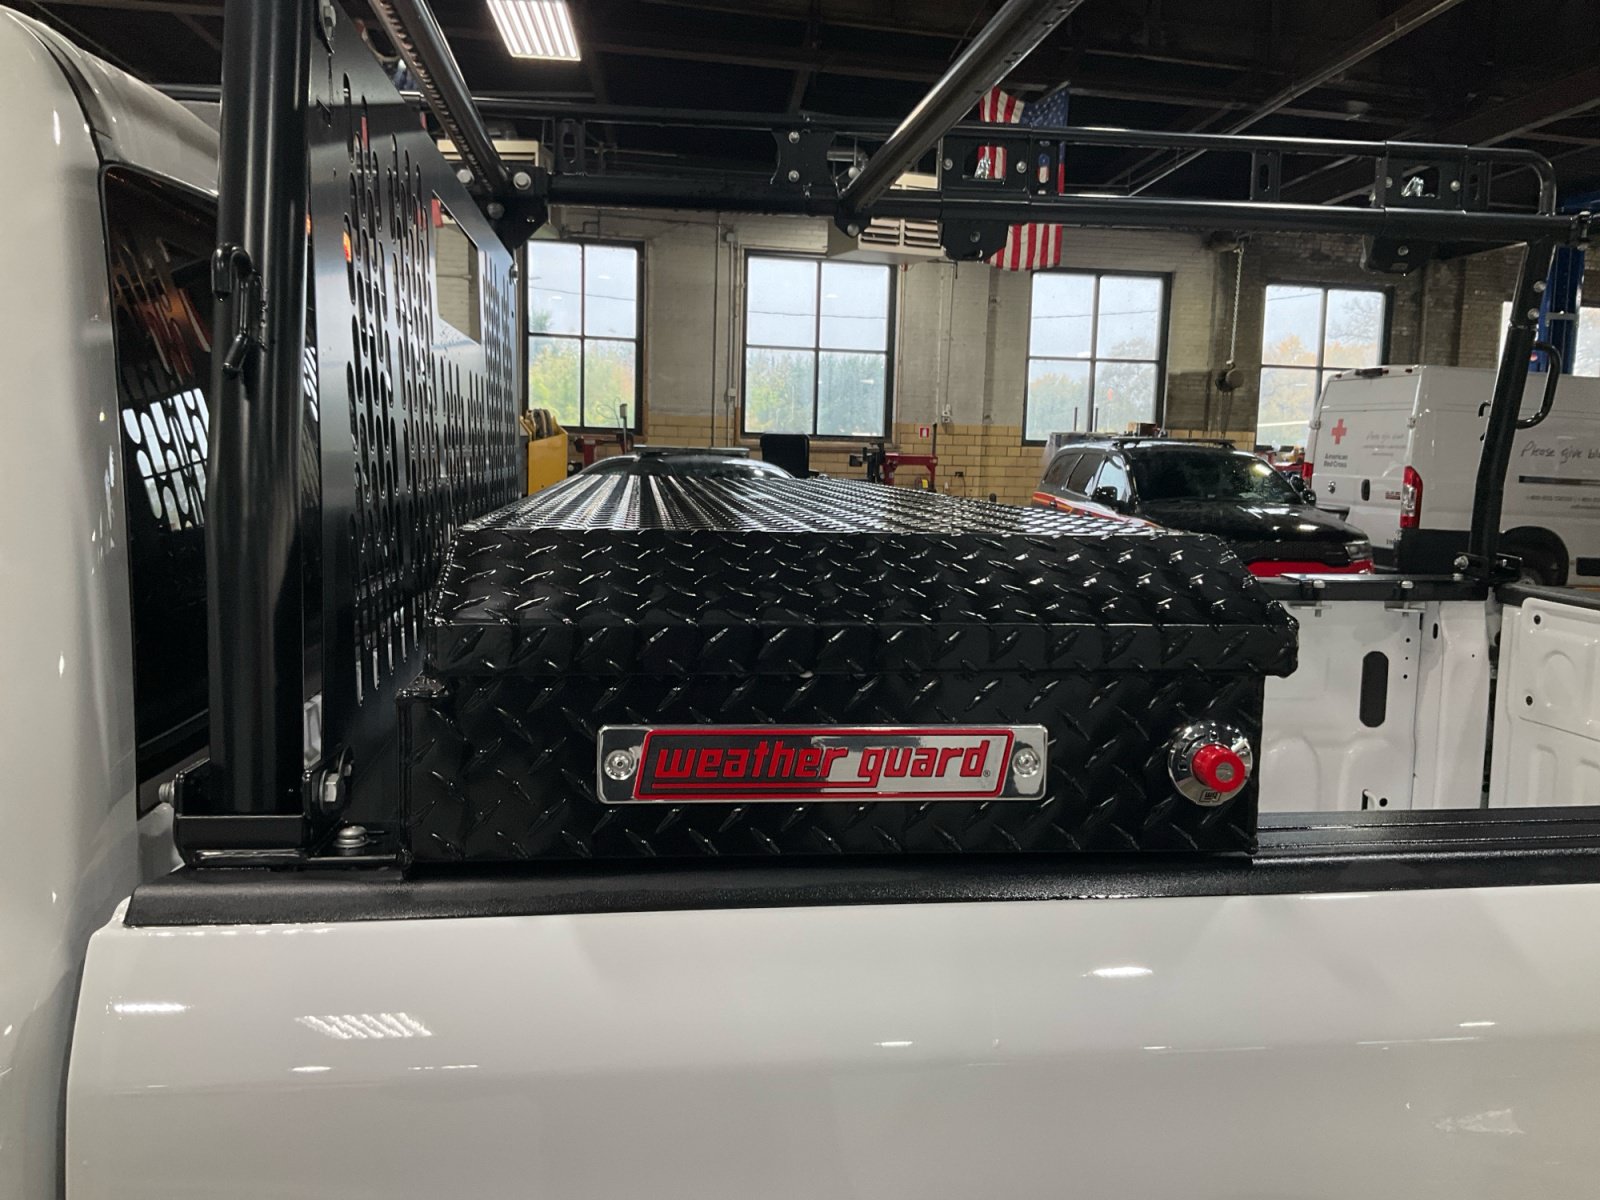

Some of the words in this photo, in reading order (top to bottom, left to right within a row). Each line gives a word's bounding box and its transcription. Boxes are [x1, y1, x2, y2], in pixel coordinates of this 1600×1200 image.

[1521, 441, 1555, 457] Please
[1560, 445, 1583, 464] give
[654, 740, 848, 778] weather
